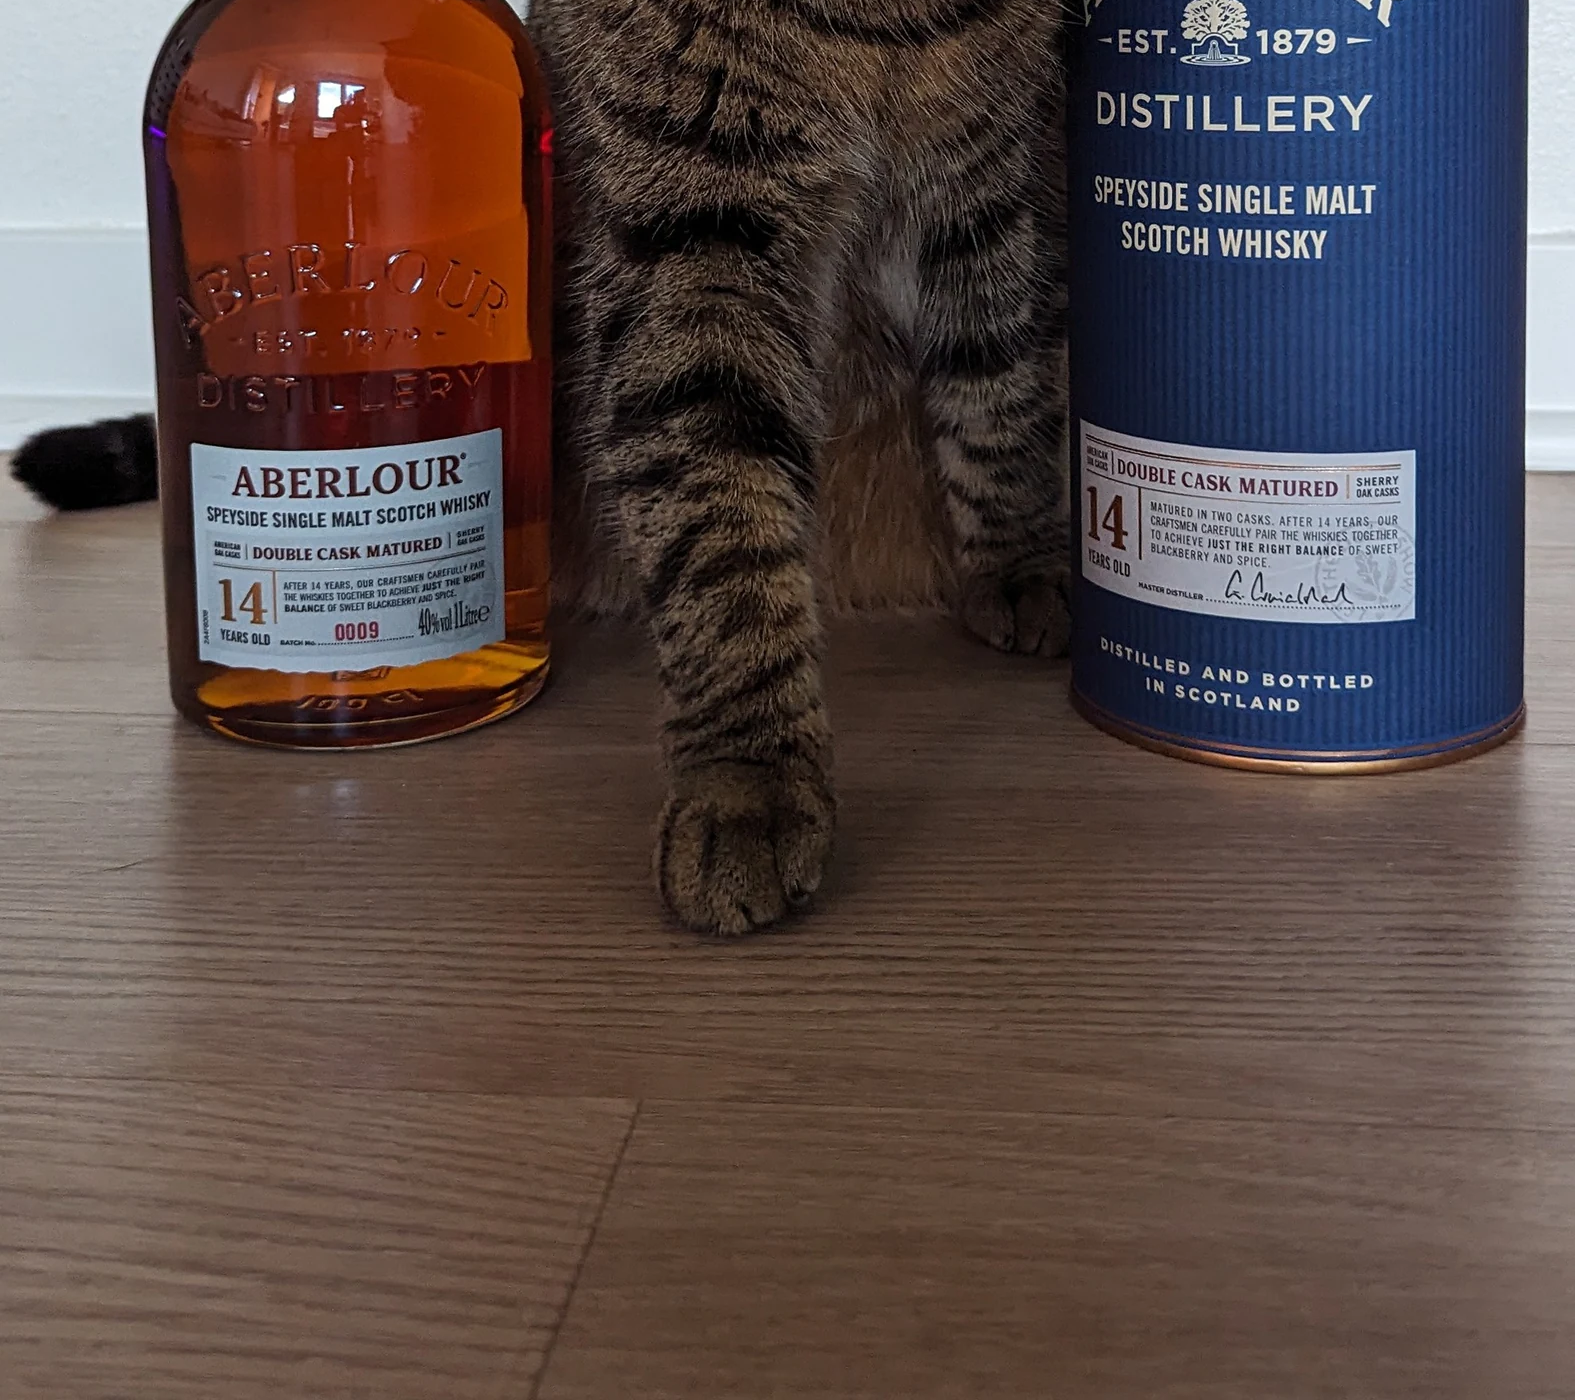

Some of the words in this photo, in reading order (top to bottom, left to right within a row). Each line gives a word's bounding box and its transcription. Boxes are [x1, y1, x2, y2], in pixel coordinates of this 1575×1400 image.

[1118, 29, 1177, 54] EST.
[1256, 29, 1336, 55] 1879
[1097, 91, 1373, 132] DISTILLERY
[1094, 175, 1189, 212] SPEYSIDE
[1197, 183, 1295, 215] SINGLE
[1305, 185, 1377, 215] MALT
[1121, 220, 1209, 257] SCOTCH
[1218, 228, 1328, 260] WHISKY
[172, 241, 508, 352] ABERLOUR
[198, 366, 486, 413] DISTILLERY
[1117, 458, 1176, 486] DOUBLE
[1181, 471, 1232, 493] CASK
[1239, 477, 1338, 498] MATURED
[1356, 475, 1399, 487] SHERRY
[1356, 488, 1373, 498] OAK
[1374, 487, 1400, 497] CASKS
[207, 506, 269, 528] SPEYSIDE
[272, 511, 327, 528] SINGLE
[332, 510, 372, 528] MALT
[376, 502, 436, 525] SCOTCH
[440, 490, 491, 515] WHISKY
[1087, 486, 1128, 551] 14
[1150, 501, 1193, 518] MATURED
[1197, 509, 1207, 520] IN
[1211, 511, 1232, 523] TWO
[1236, 513, 1274, 526] CASKS.
[1279, 515, 1313, 527] AFTER
[1318, 517, 1330, 528] 14
[1335, 516, 1373, 529] YEARS,
[1378, 514, 1398, 526] OUR
[1150, 515, 1198, 533] CRAFTSMEN
[1201, 523, 1252, 538] CAREFULLY
[1255, 529, 1277, 540] PAIR
[1280, 530, 1299, 542] THE
[1302, 530, 1348, 542] WHISKIES
[1352, 529, 1398, 542] TOGETHER
[1150, 529, 1161, 541] TO
[1164, 532, 1203, 548] ACHIEVE
[1207, 539, 1231, 551] JUST
[1235, 541, 1254, 553] THE
[1258, 543, 1291, 555] RIGHT
[1295, 545, 1344, 556] BALANCE
[1349, 545, 1361, 555] OF
[1365, 543, 1398, 555] SWEET
[253, 546, 313, 561] DOUBLE
[317, 546, 361, 561] CASK
[366, 536, 443, 558] MATURED
[1088, 547, 1111, 571] YEARS
[1113, 559, 1131, 578] OLD
[1150, 542, 1210, 562] BLACKBERRY
[1213, 553, 1233, 565] AND
[1237, 555, 1271, 568] SPICE.
[283, 581, 308, 590] AFTER
[311, 581, 321, 590] 14
[324, 580, 354, 590] YEARS,
[357, 579, 374, 588] OUR
[377, 572, 425, 587] CRAFTSMEN
[427, 565, 468, 580] CAREFULLY
[470, 559, 485, 571] PAIR
[283, 593, 298, 602] THE
[300, 592, 334, 602] WHISKIES
[337, 590, 375, 601] TOGETHER
[377, 589, 387, 598] TO
[389, 584, 420, 598] ACHIEVE
[421, 580, 442, 592] JUST
[445, 577, 461, 587] THE
[463, 570, 486, 583] RIGHT
[218, 578, 268, 625] 14
[284, 603, 325, 612] BALANCE
[327, 603, 337, 612] OF
[340, 602, 365, 612] SWEET
[367, 596, 416, 610] BLACKBERRY
[418, 593, 433, 603] AND
[435, 589, 457, 601] SPICE.
[1138, 581, 1165, 594] MASTER
[1166, 588, 1204, 600] DISTILLER
[220, 628, 249, 644] YEARS
[251, 632, 271, 646] OLD
[335, 621, 379, 641] 0009
[1100, 636, 1191, 676] DISTILLED
[1202, 666, 1249, 685] AND
[1262, 674, 1374, 690] BOTTLED
[1146, 677, 1165, 695] IN
[1175, 684, 1300, 713] SCOTLAND
